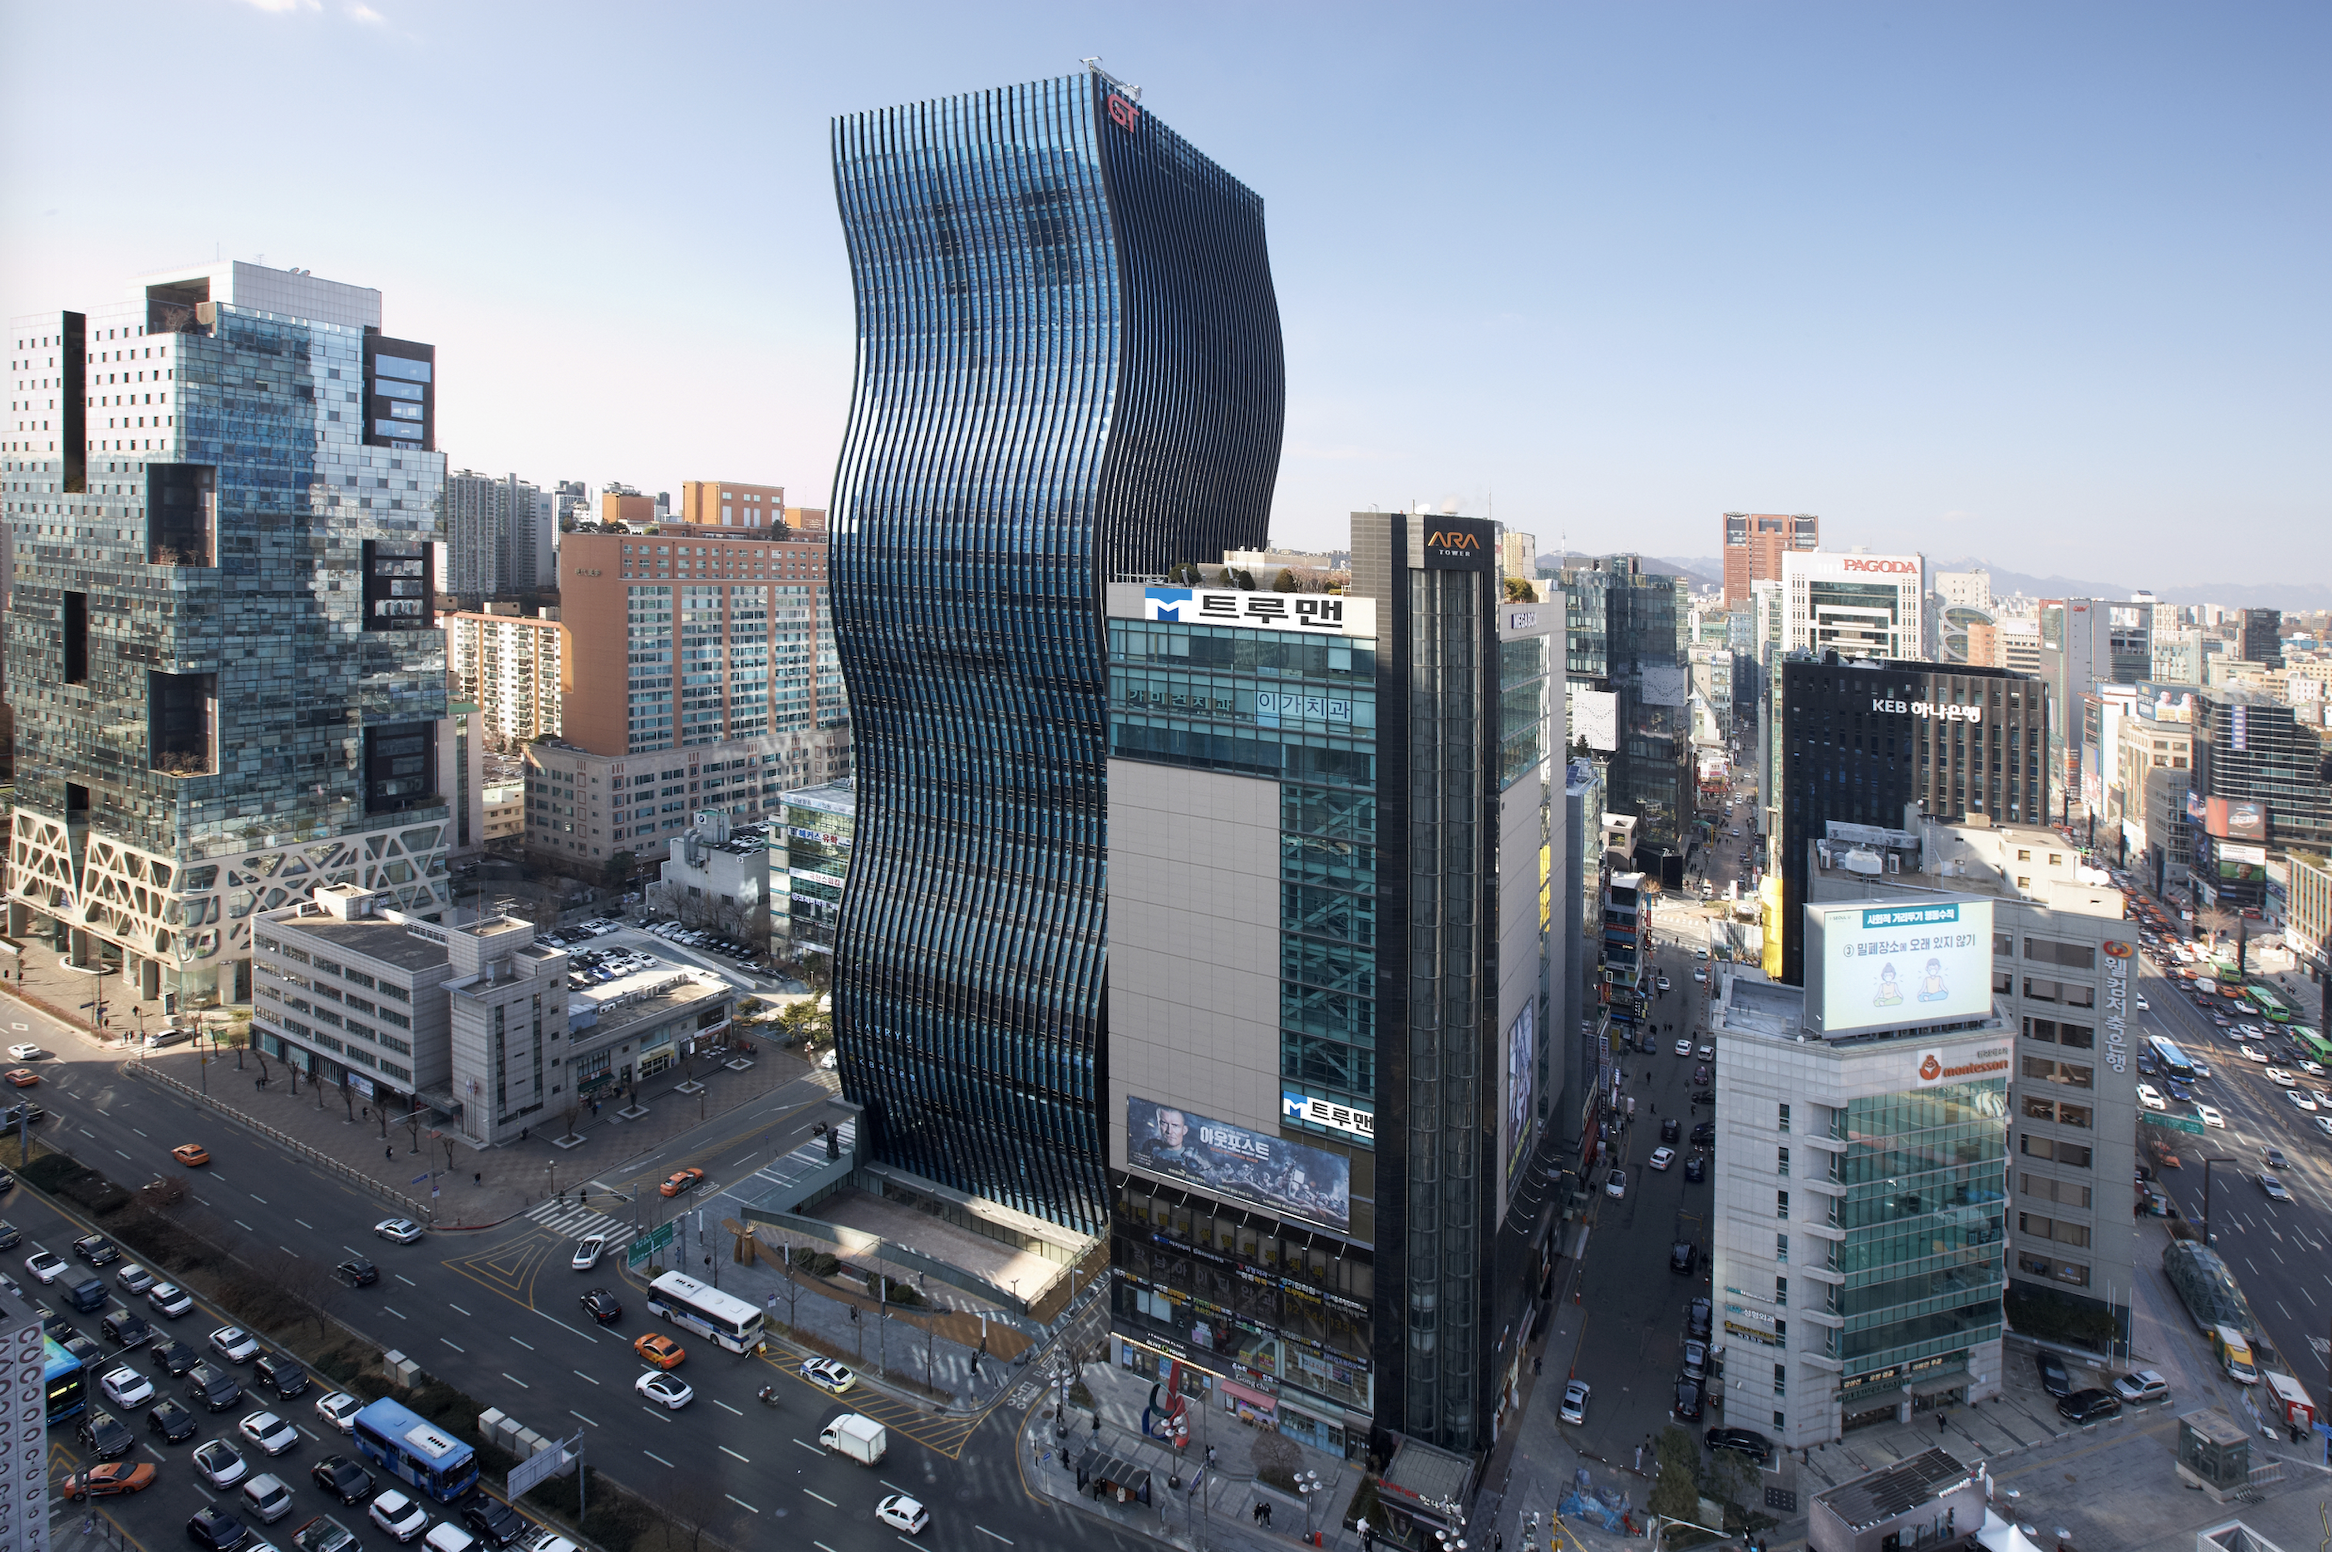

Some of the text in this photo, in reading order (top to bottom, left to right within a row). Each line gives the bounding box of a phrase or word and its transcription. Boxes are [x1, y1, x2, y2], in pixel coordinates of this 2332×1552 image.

[1427, 531, 1480, 549] ARA
[1439, 549, 1471, 557] TOWER
[1843, 559, 1918, 574] PAGODA
[1199, 595, 1343, 629] 트루맨
[1511, 612, 1538, 629] MEGABOX
[1259, 692, 1350, 719] 이가치과
[1872, 699, 1982, 723] KEB 하나은행
[1867, 908, 1955, 925] 사회적 거리두기 행동수칙
[1857, 941, 1907, 956] 밀폐장소에
[1909, 937, 1930, 952] 오래
[1933, 935, 1953, 950] 있지
[1956, 934, 1976, 948] 않기
[2104, 956, 2127, 1074] 웰컴저축은행
[1943, 1060, 2008, 1077] montessori
[1310, 1101, 1373, 1134] 트루맨
[1200, 1126, 1270, 1161] 아웃포스트
[1286, 1302, 1299, 1315] 02
[1743, 1307, 1775, 1324] 성형외과
[1146, 1339, 1161, 1349] OLIVE
[1169, 1348, 1187, 1359] YOUNG
[1324, 1352, 1358, 1370] MEGABOX
[1235, 1373, 1270, 1393] Gong cha
